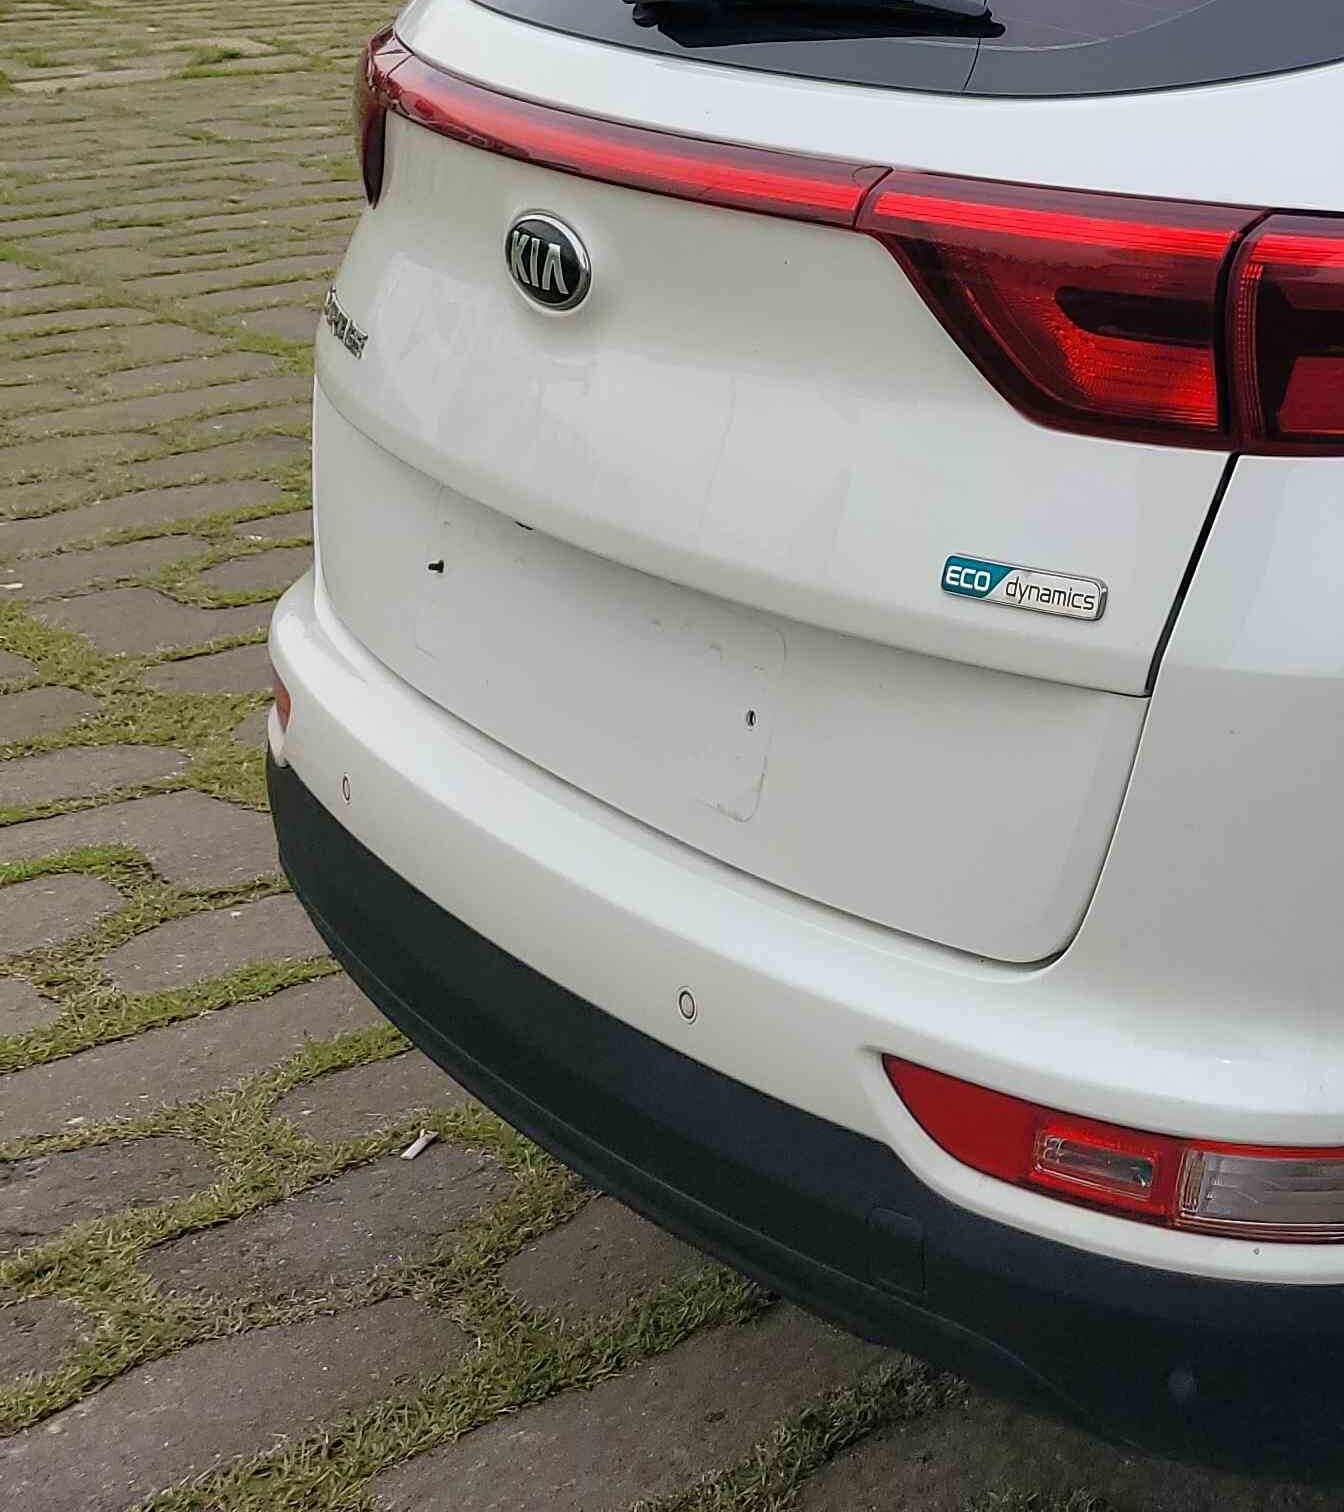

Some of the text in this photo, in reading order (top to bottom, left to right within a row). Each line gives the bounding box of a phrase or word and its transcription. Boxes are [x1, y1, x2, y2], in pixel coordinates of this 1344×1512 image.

[511, 229, 570, 295] KIA
[945, 565, 1096, 611] ECO dynamics
